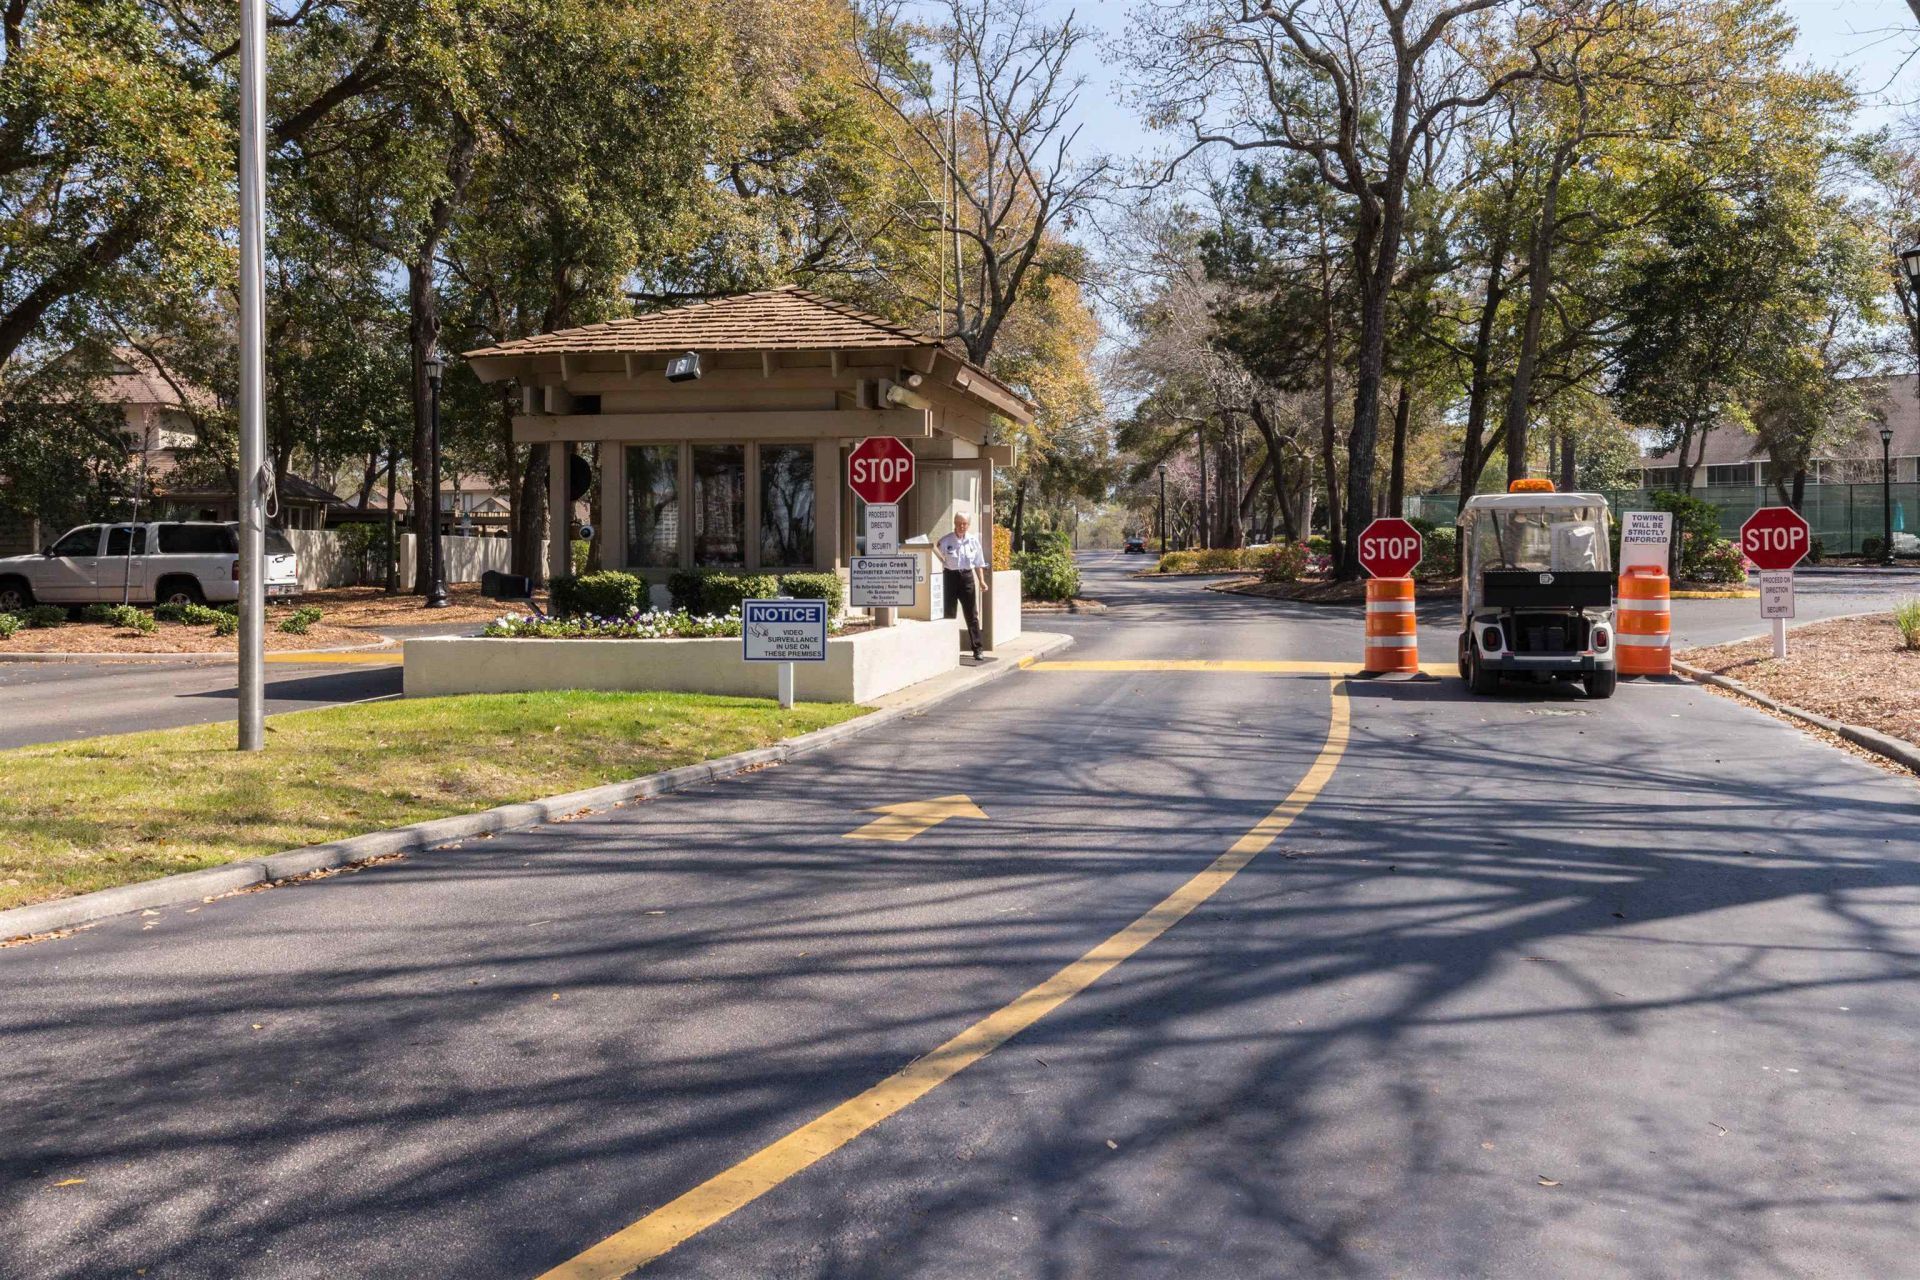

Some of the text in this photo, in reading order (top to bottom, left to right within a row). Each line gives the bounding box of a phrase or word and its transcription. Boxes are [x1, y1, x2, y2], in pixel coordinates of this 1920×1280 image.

[853, 458, 910, 483] STOP
[870, 521, 893, 529] DIRECTION
[1746, 527, 1804, 552] STOP
[871, 542, 892, 550] SECURITY
[1363, 537, 1418, 560] STOP
[1762, 576, 1784, 584] PROCEED
[1765, 586, 1789, 594] DIRECTION
[1766, 606, 1788, 614] SECURITY
[753, 608, 816, 621] NOTICE
